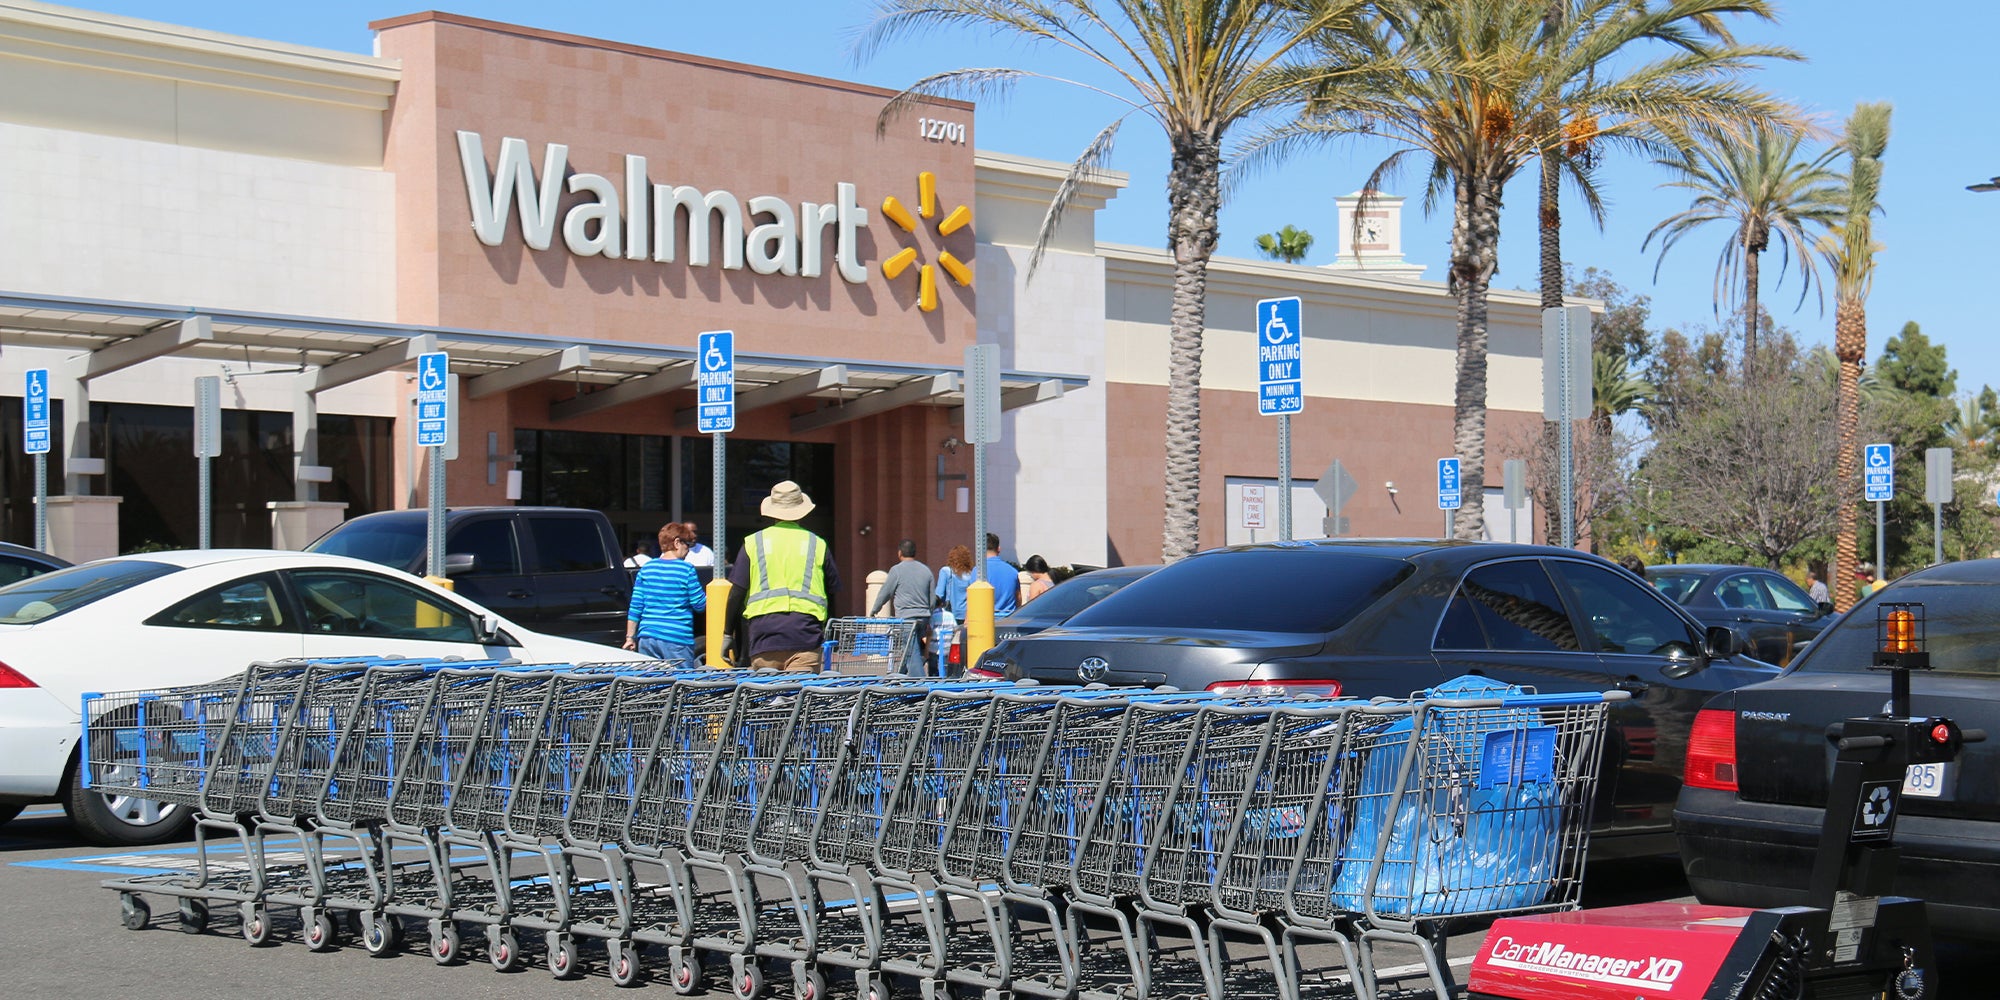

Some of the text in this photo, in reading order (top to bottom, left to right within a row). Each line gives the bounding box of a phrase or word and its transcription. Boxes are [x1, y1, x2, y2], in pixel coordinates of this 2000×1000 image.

[919, 118, 965, 143] 12701
[456, 130, 868, 284] Walmart
[1260, 344, 1300, 362] PARKING
[1268, 362, 1292, 380] ONLY
[701, 371, 732, 386] PARKING
[420, 390, 446, 402] PARKING
[706, 387, 726, 402] ONLY
[1266, 384, 1294, 396] MINIMUM
[1262, 397, 1300, 410] FINE $250
[424, 404, 440, 418] ONLY
[704, 406, 727, 416] MINIMUM
[701, 417, 731, 428] FINE $250
[1867, 466, 1890, 474] PARKING
[1872, 476, 1886, 484] ONLY
[1742, 710, 1790, 721] PASSAT
[1906, 765, 1935, 788] 85
[1642, 956, 1683, 982] XD
